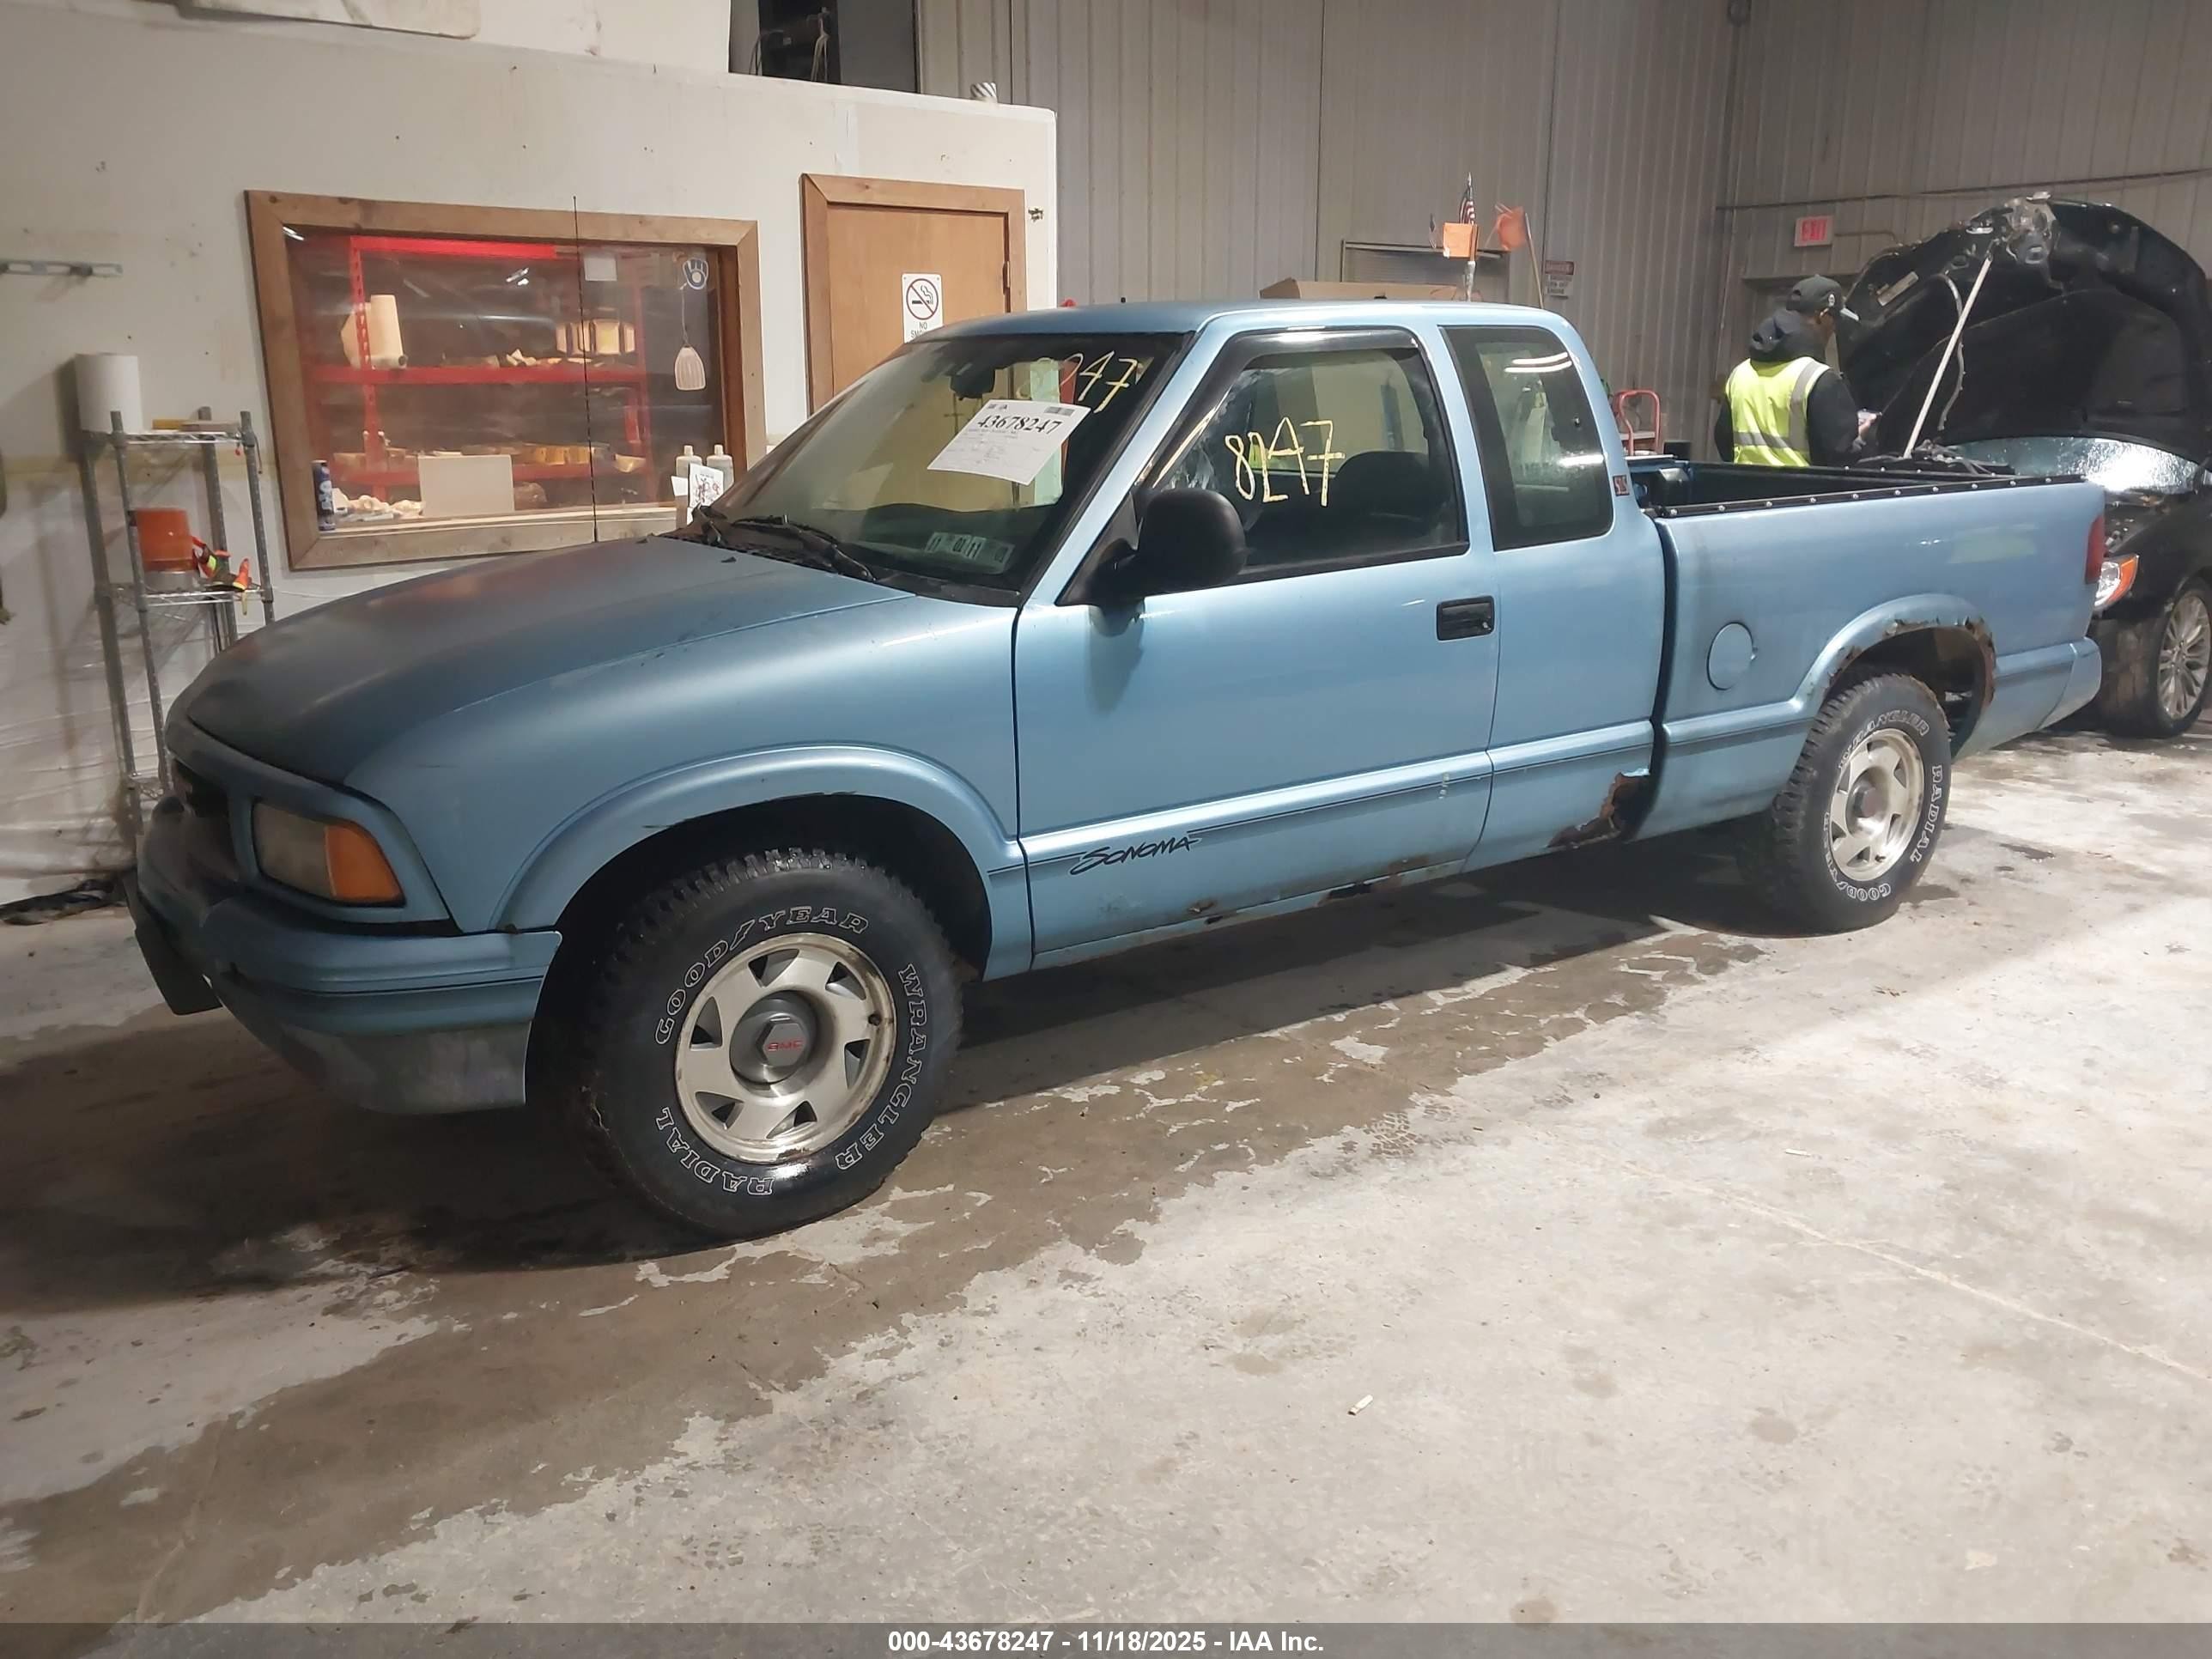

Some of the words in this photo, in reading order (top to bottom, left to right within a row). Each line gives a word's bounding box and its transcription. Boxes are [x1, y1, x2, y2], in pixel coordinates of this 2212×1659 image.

[919, 321, 928, 331] NO
[977, 414, 1063, 434] 43678247
[1070, 836, 1200, 875] SONOMA
[654, 905, 869, 1045] GOODYEAR
[835, 963, 927, 1170] WRANGLER
[654, 1107, 775, 1196] RADIAL
